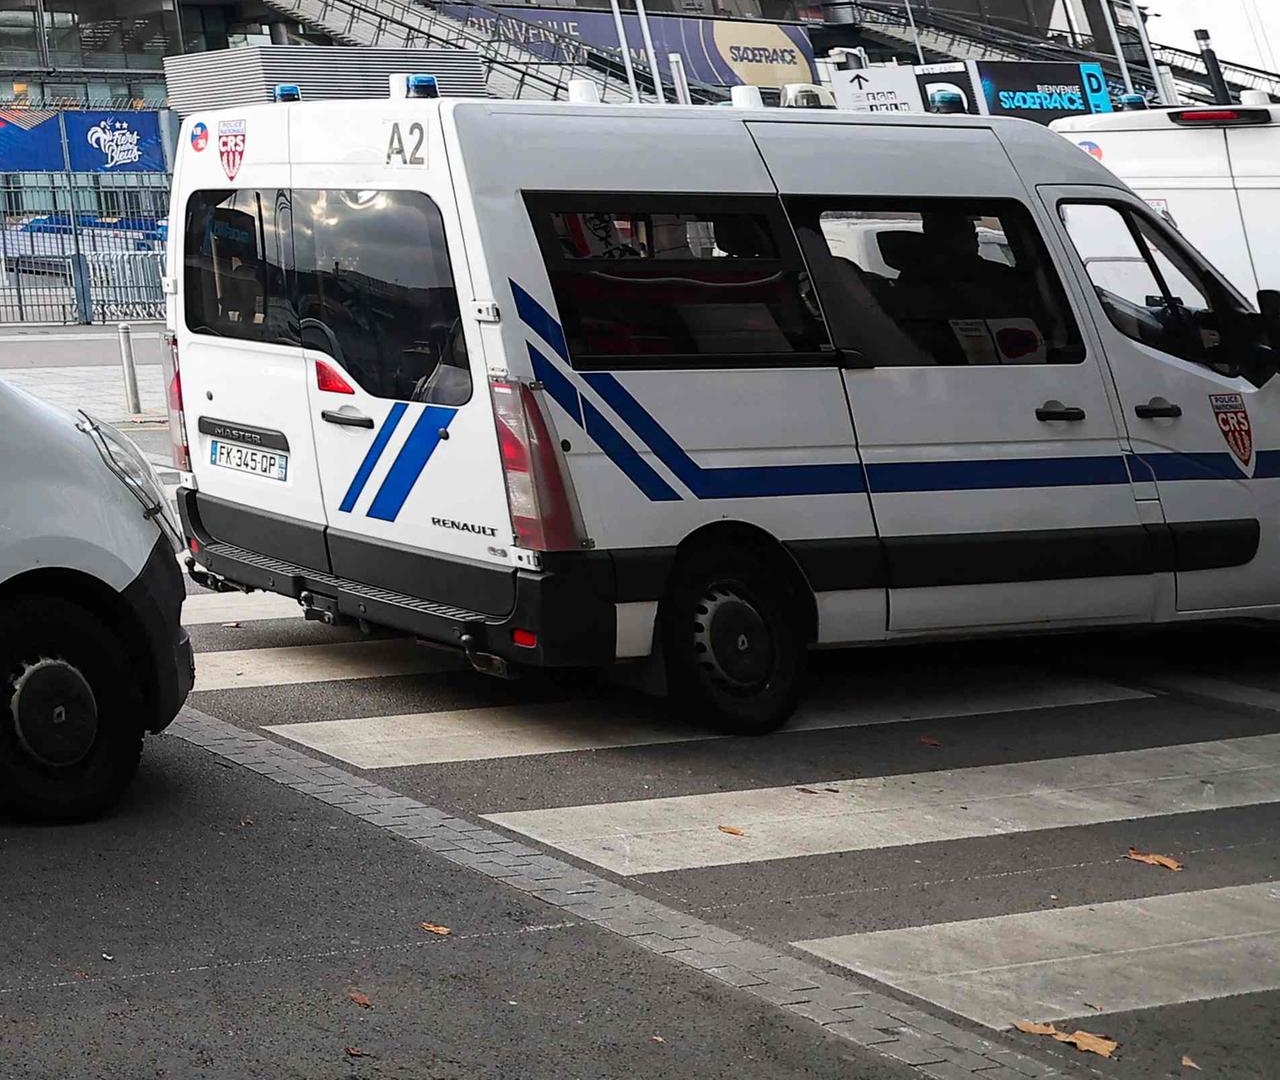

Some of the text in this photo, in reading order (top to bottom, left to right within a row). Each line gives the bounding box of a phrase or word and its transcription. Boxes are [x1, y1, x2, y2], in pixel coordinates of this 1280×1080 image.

[1037, 84, 1082, 94] BIENVENUE
[1086, 73, 1102, 94] D
[219, 135, 244, 152] CRS
[386, 122, 424, 165] A2
[1218, 412, 1249, 431] CRS
[215, 427, 262, 443] MASTER
[218, 446, 276, 474] FK-345-QP
[431, 517, 498, 537] RENAULT
